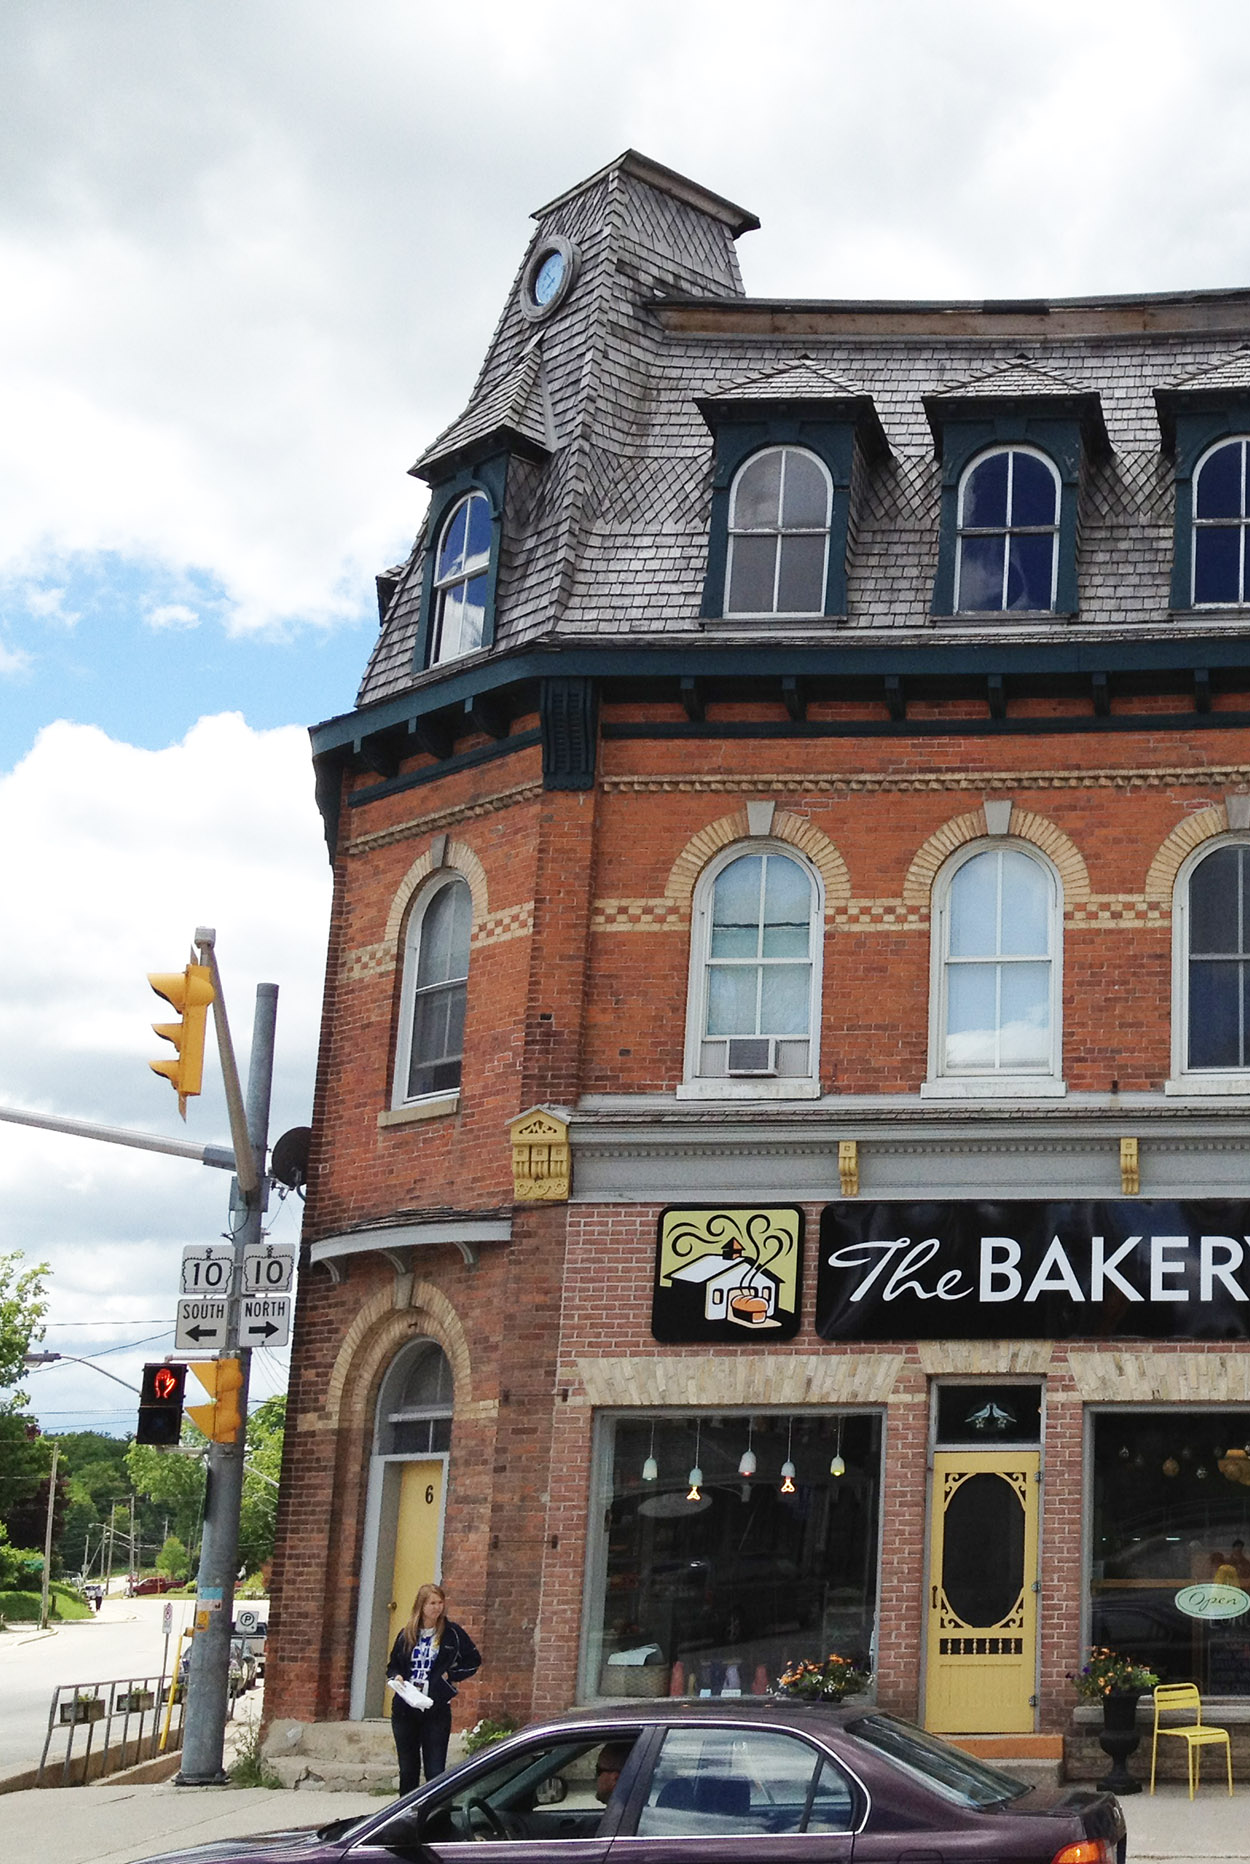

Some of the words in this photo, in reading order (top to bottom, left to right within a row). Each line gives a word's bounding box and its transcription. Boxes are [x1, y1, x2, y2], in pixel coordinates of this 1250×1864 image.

[193, 1262, 223, 1286] 10
[255, 1260, 284, 1284] 10
[828, 1236, 974, 1302] The
[183, 1303, 225, 1319] SOUTH
[245, 1301, 286, 1317] NORTH
[425, 1484, 433, 1504] 6
[1188, 1591, 1236, 1612] Open
